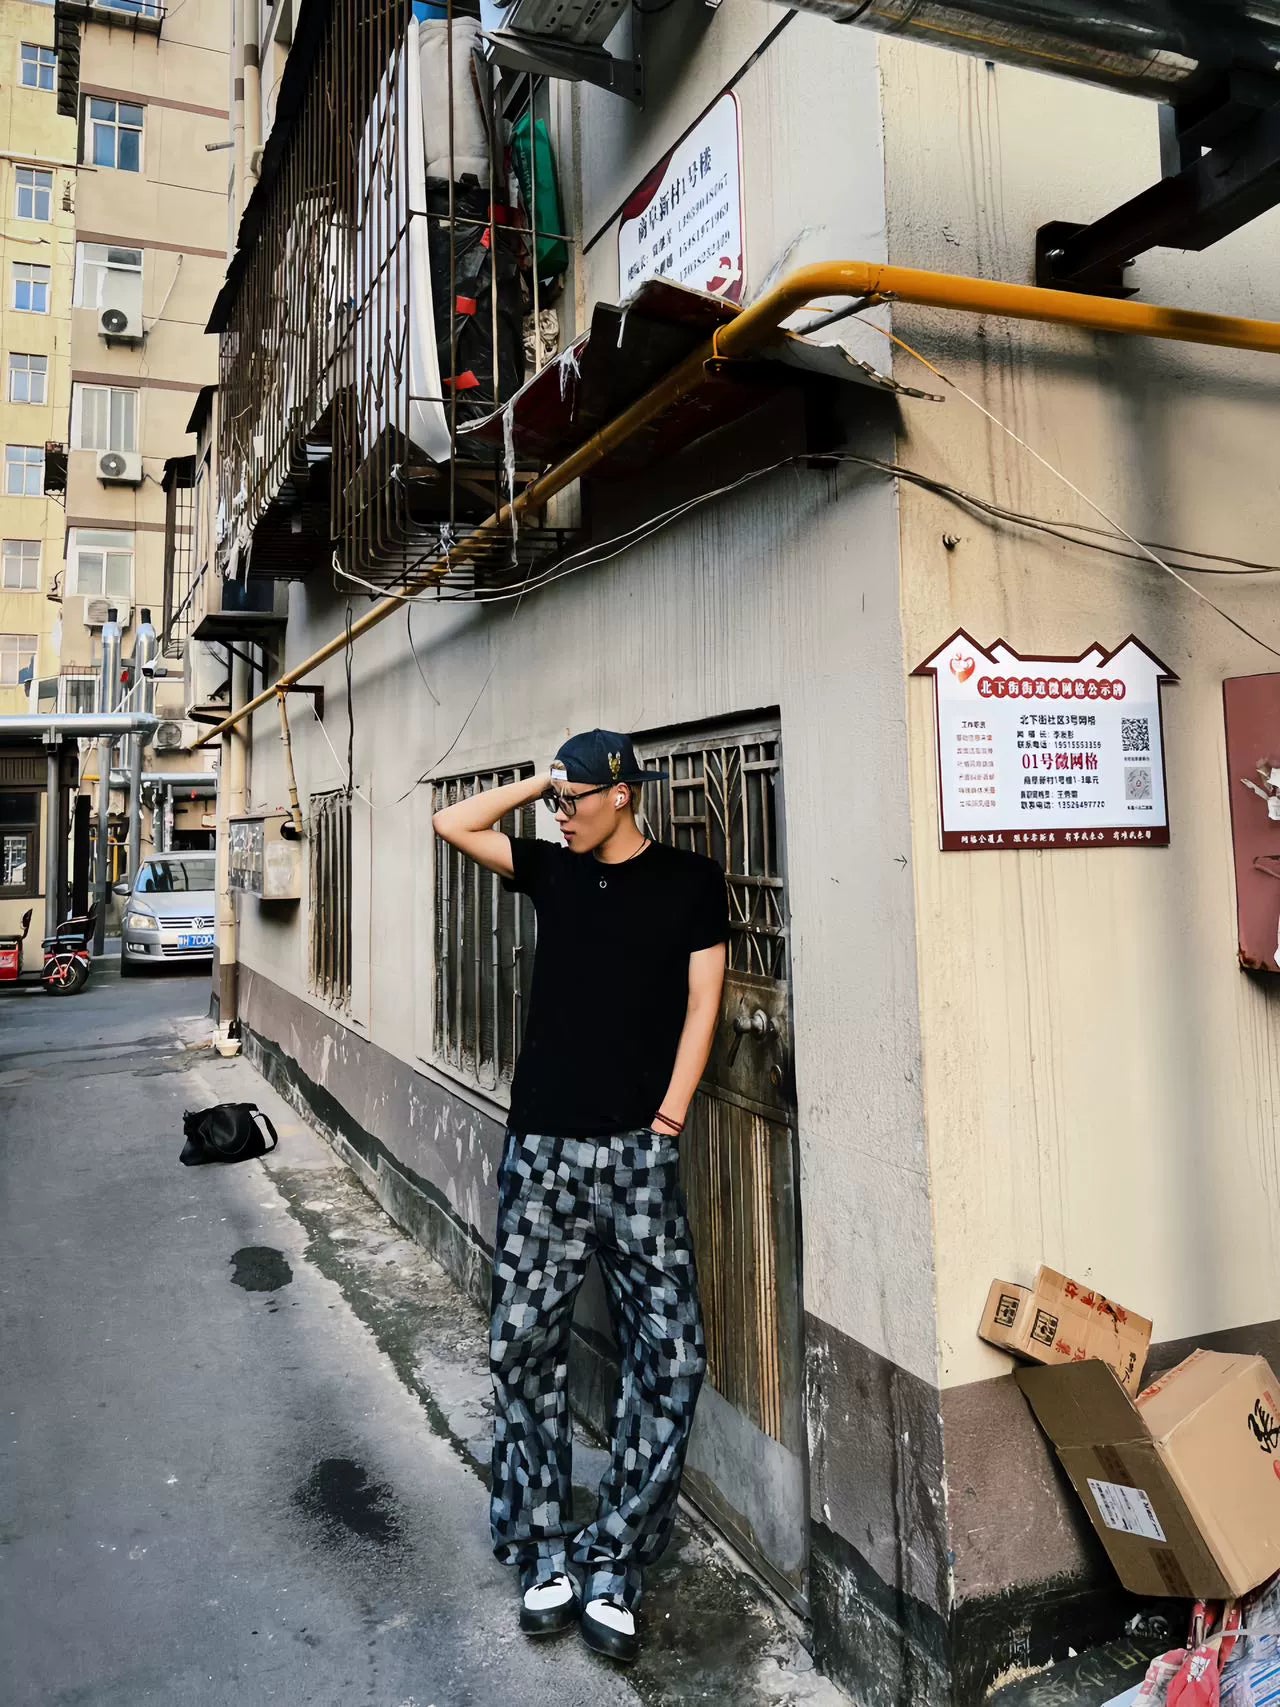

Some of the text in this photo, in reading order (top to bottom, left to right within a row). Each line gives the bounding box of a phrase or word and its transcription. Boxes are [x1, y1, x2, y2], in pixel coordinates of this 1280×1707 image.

[980, 679, 1124, 698] 北下街街道微网格公示牌
[1019, 714, 1096, 726] 北下街社区3号网格
[1021, 752, 1098, 770] 01号微网格
